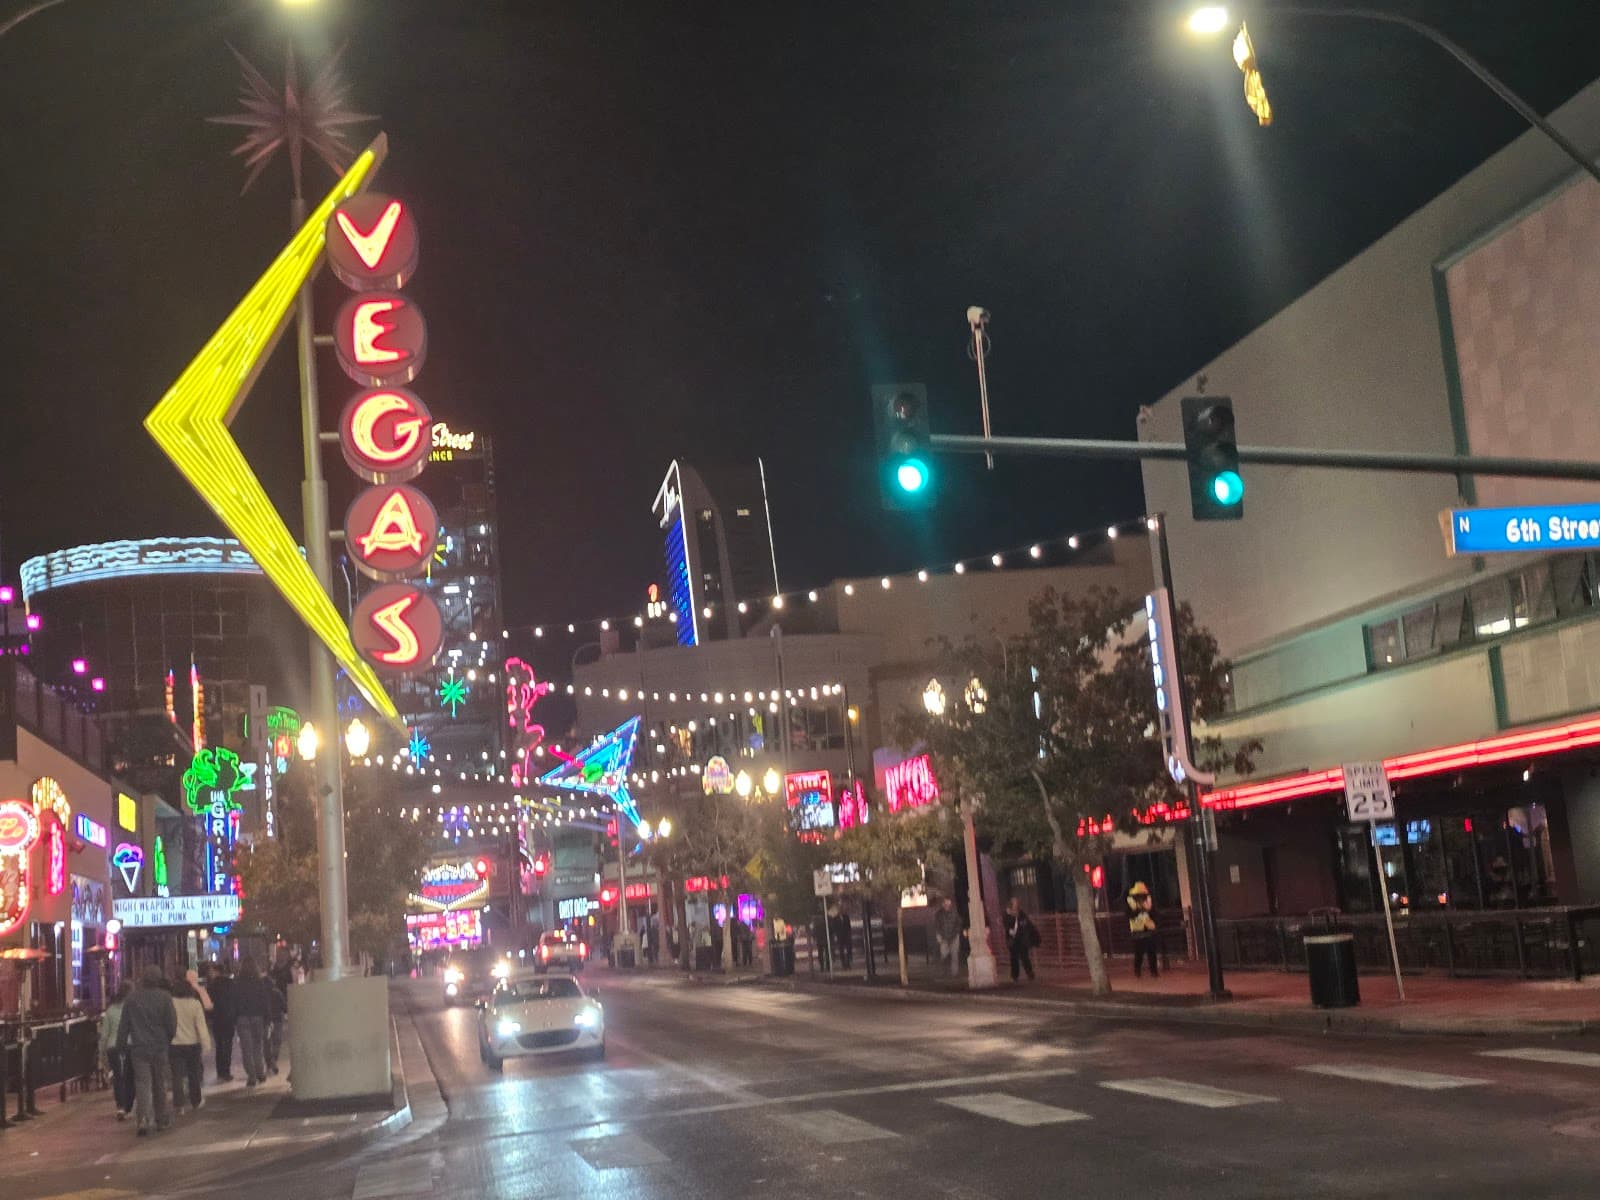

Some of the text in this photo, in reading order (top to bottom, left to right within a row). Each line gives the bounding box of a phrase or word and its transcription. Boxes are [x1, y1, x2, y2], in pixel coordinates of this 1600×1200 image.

[335, 200, 429, 666] VEGAS
[1459, 515, 1600, 543] N 6th Stree
[1346, 764, 1384, 777] SPEED
[1352, 778, 1381, 790] LIMIT
[1352, 790, 1388, 814] 25
[114, 901, 137, 913] NIGHT
[138, 900, 175, 912] WEAPONS
[181, 898, 196, 910] ALL
[200, 897, 221, 909] VINYL
[134, 913, 145, 925] DJ
[168, 911, 187, 922] PUNK
[200, 910, 215, 921] SAT
